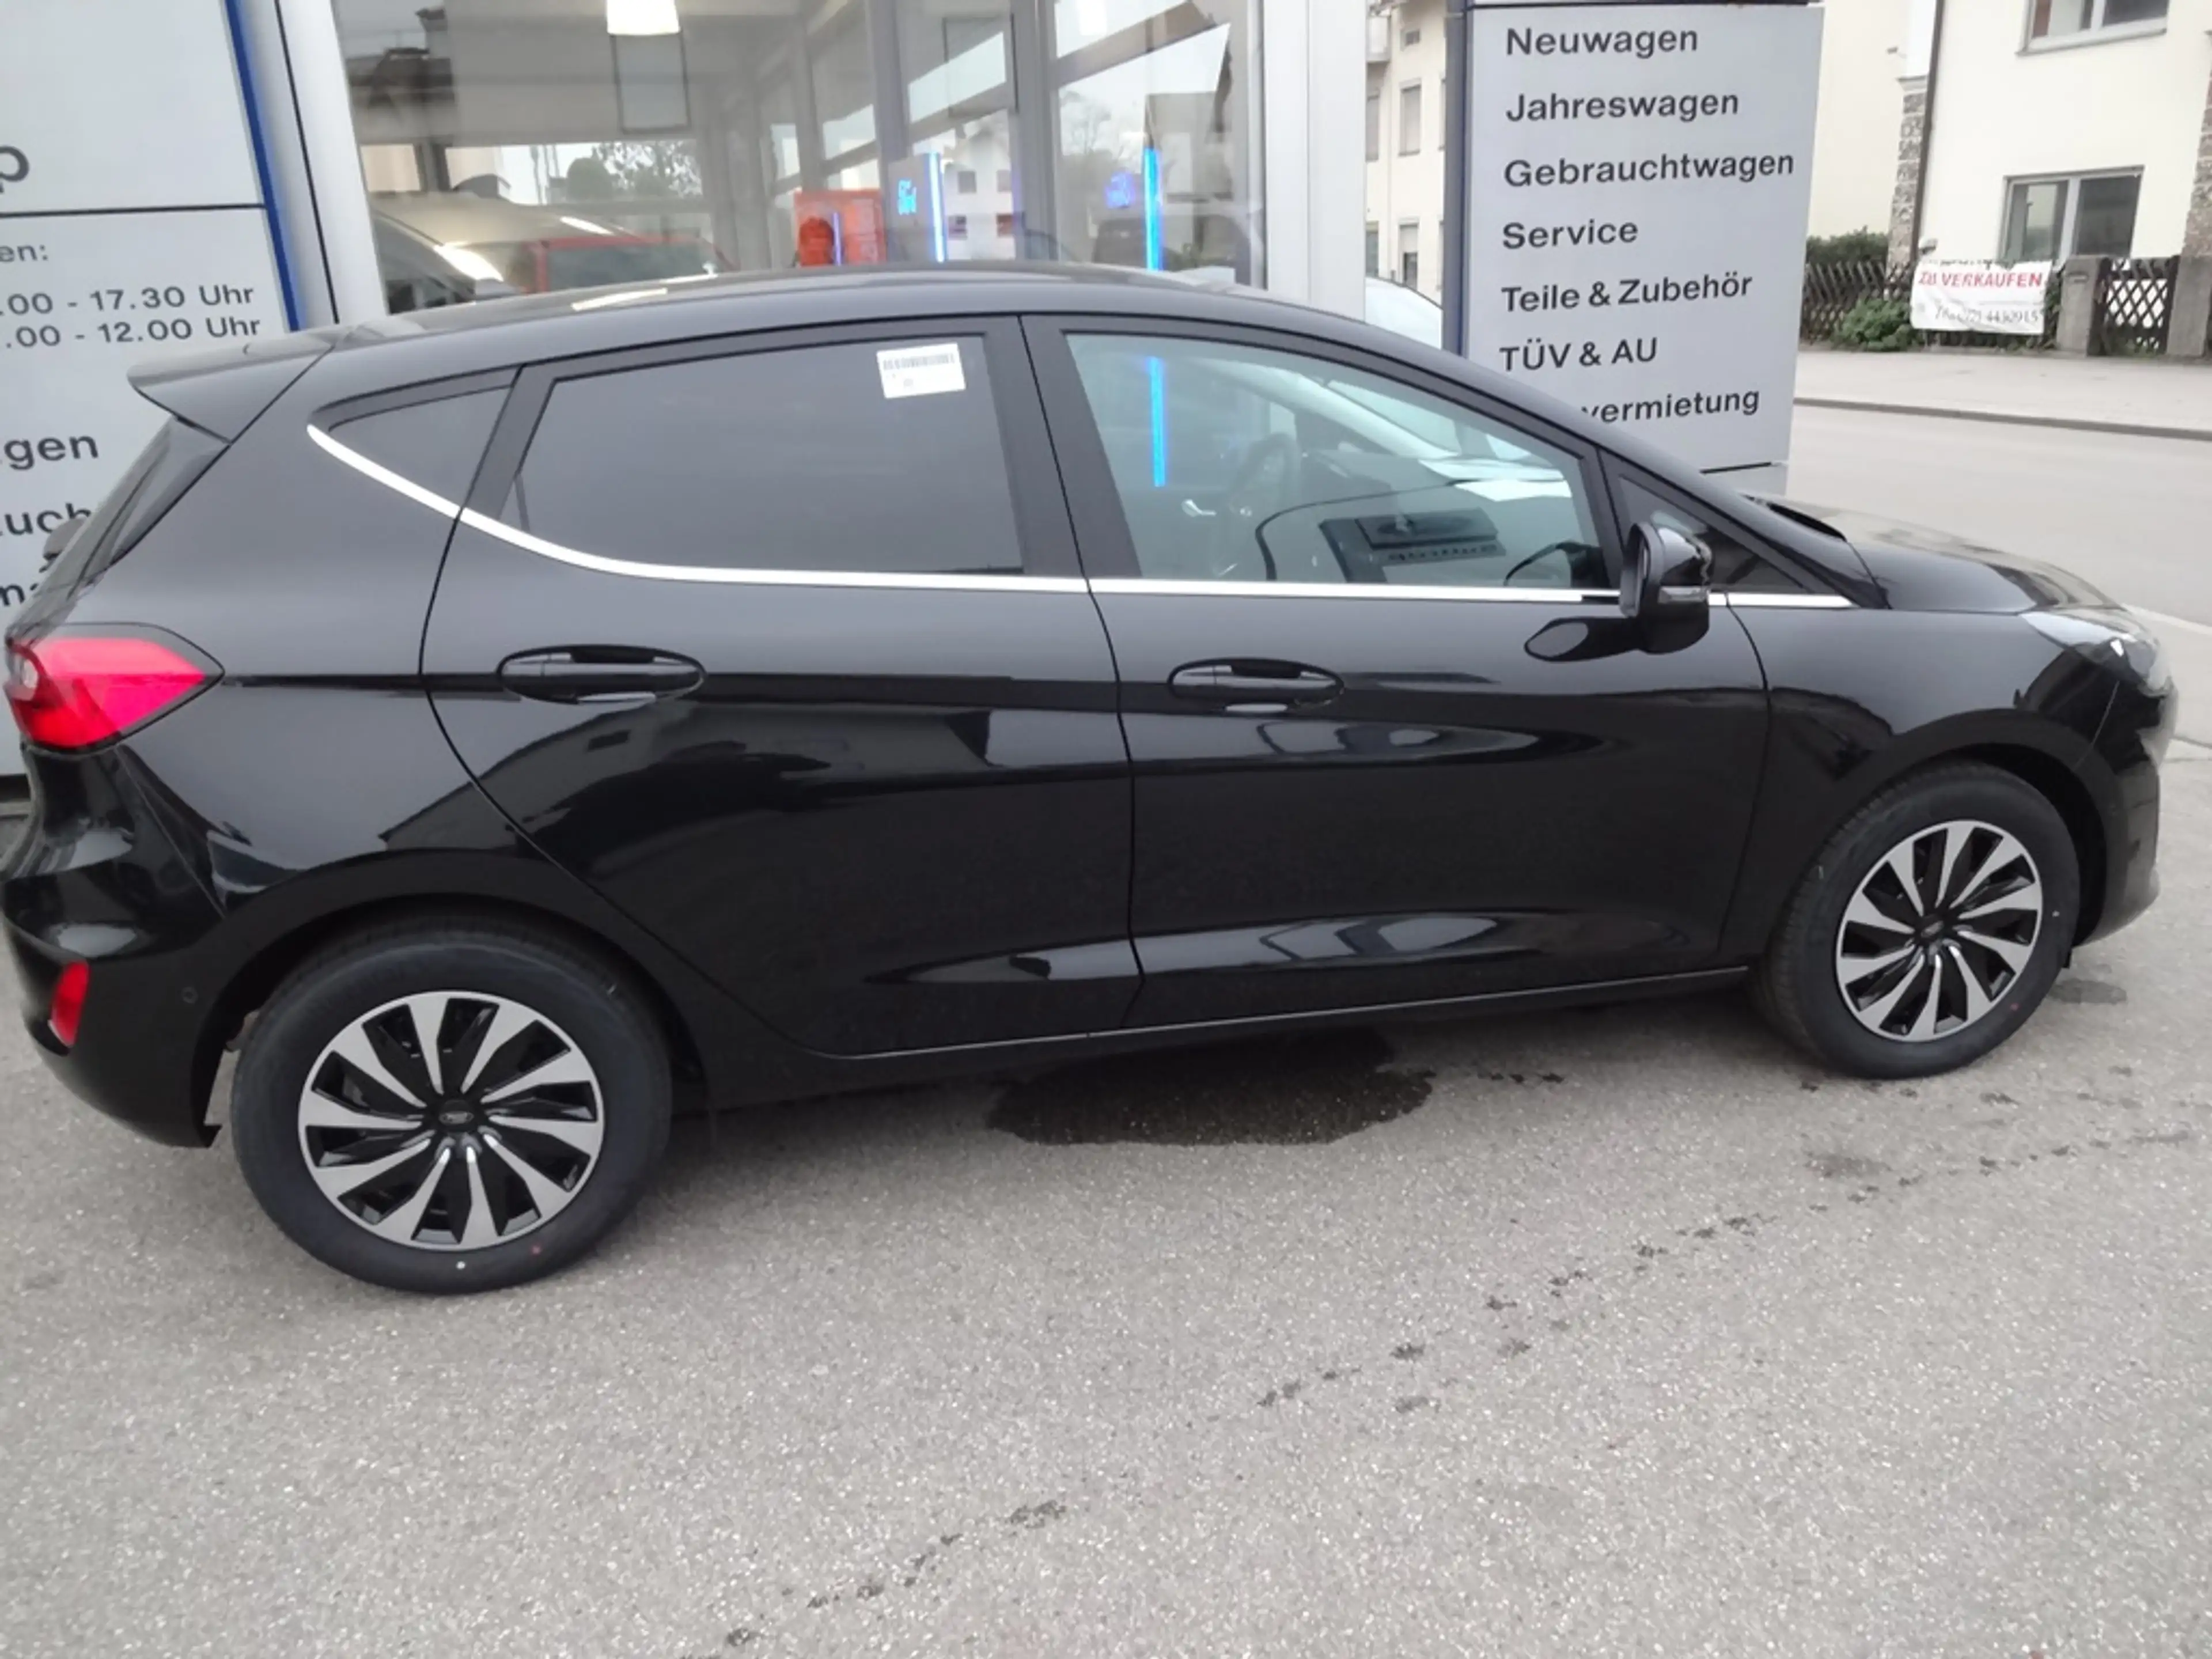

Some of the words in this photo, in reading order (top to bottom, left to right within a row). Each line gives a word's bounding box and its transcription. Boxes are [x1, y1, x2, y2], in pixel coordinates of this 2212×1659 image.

[1506, 27, 1698, 59] Neuwagen
[1505, 92, 1739, 123] Jahreswagen
[1503, 153, 1794, 187] Gebrauchtwagen
[1502, 218, 1639, 250] Service
[1501, 283, 1581, 312] Teile
[1588, 281, 1611, 308] &
[1618, 270, 1753, 305] Zubehör
[1941, 272, 2043, 287] VERKAUFEN
[89, 285, 185, 312] 17.30
[198, 284, 254, 306] Uhr
[97, 317, 193, 344] 12.00
[204, 316, 261, 339] Uhr
[1499, 339, 1571, 372] TÜV
[1578, 341, 1601, 368] &
[1611, 336, 1658, 365] AU
[0, 435, 100, 471] gen
